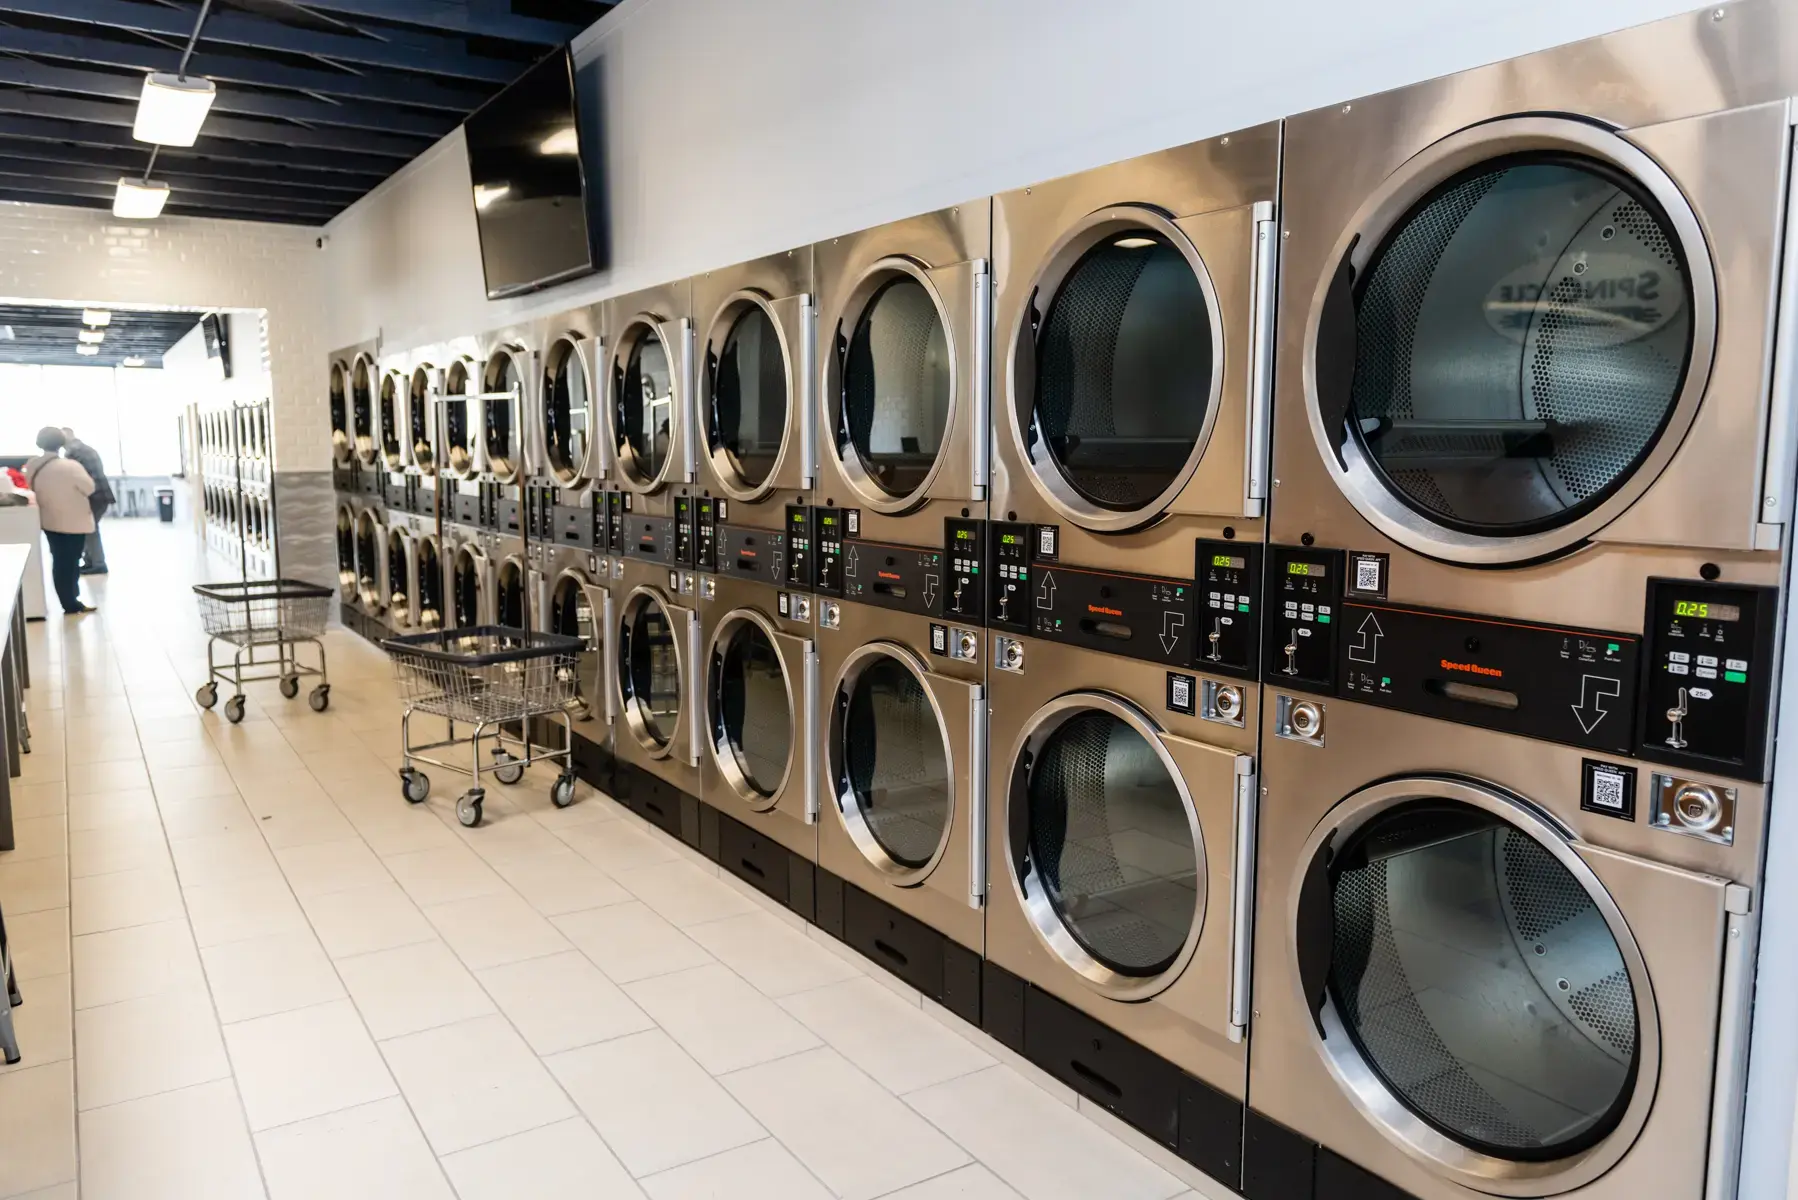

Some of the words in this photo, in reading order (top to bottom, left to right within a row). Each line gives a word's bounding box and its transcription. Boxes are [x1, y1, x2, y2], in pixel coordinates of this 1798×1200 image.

[1213, 555, 1230, 567] 0.25
[1289, 563, 1308, 575] 0.25
[1676, 602, 1708, 617] 0.25
[1441, 659, 1470, 671] Speed
[1471, 664, 1502, 677] Queen
